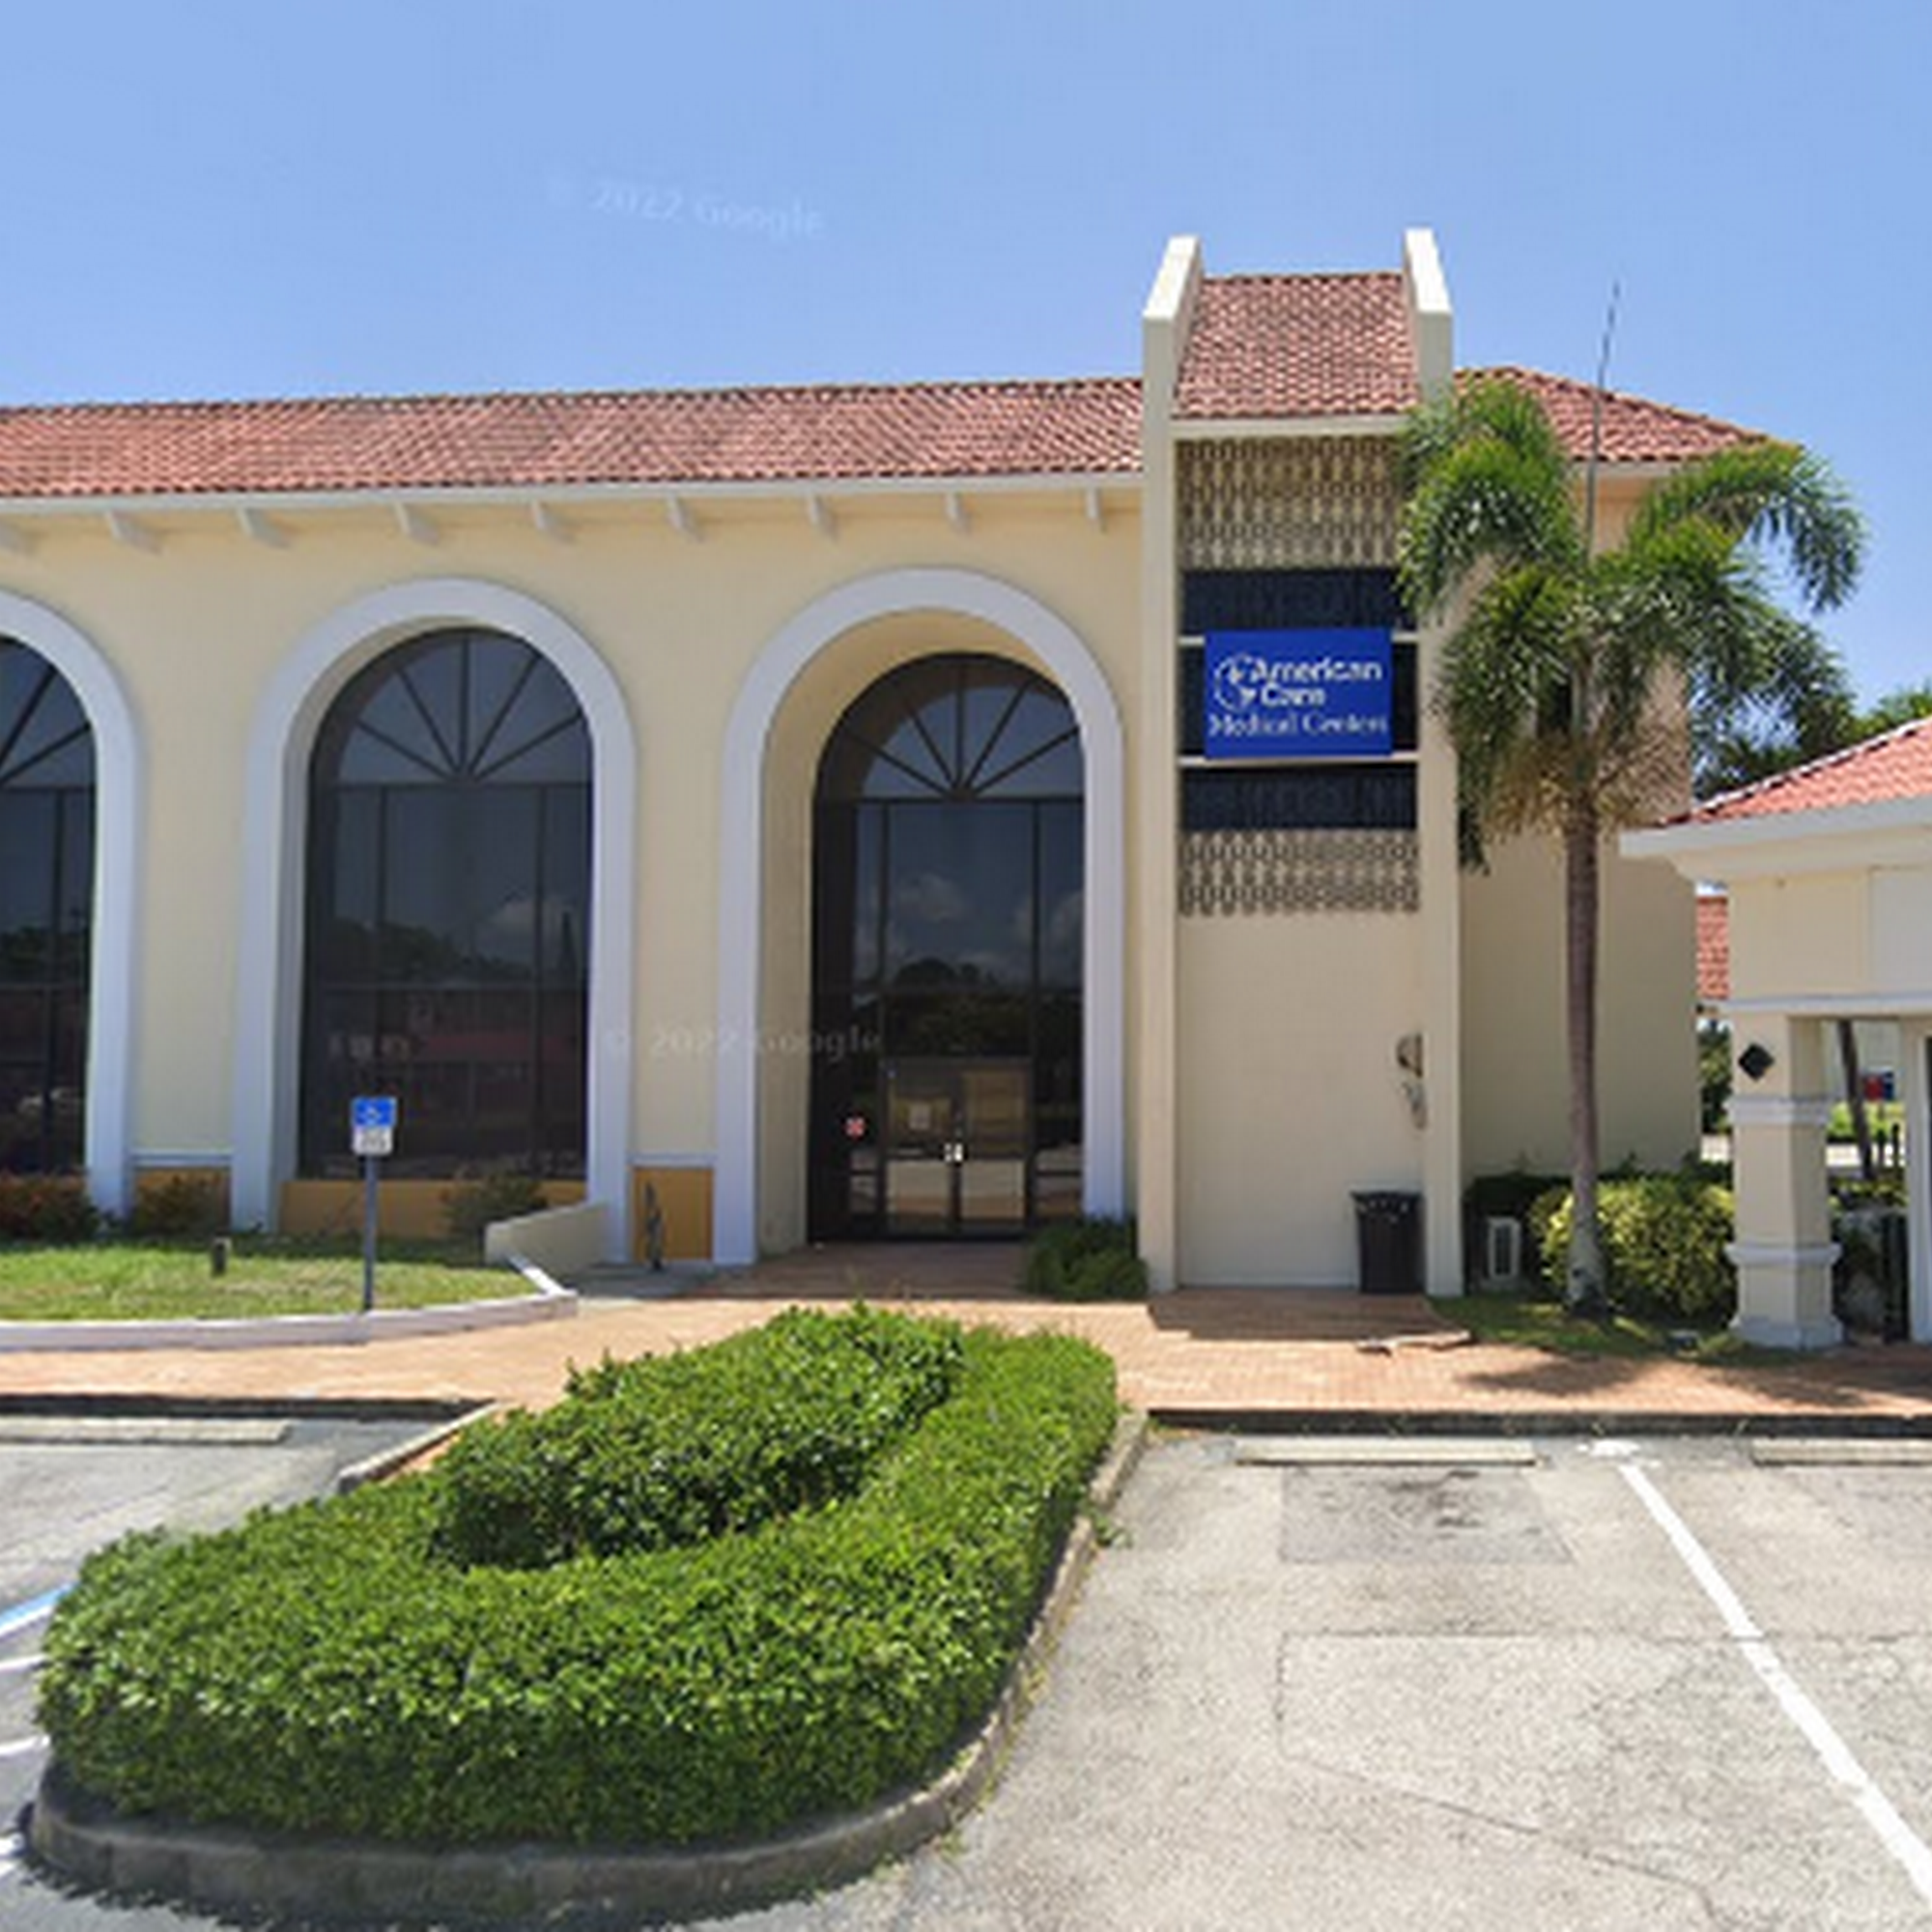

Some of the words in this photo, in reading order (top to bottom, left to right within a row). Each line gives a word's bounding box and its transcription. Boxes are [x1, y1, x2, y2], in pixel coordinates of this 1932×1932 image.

[1248, 657, 1382, 681] American
[1262, 683, 1326, 706] Care
[1208, 712, 1298, 736] Medical
